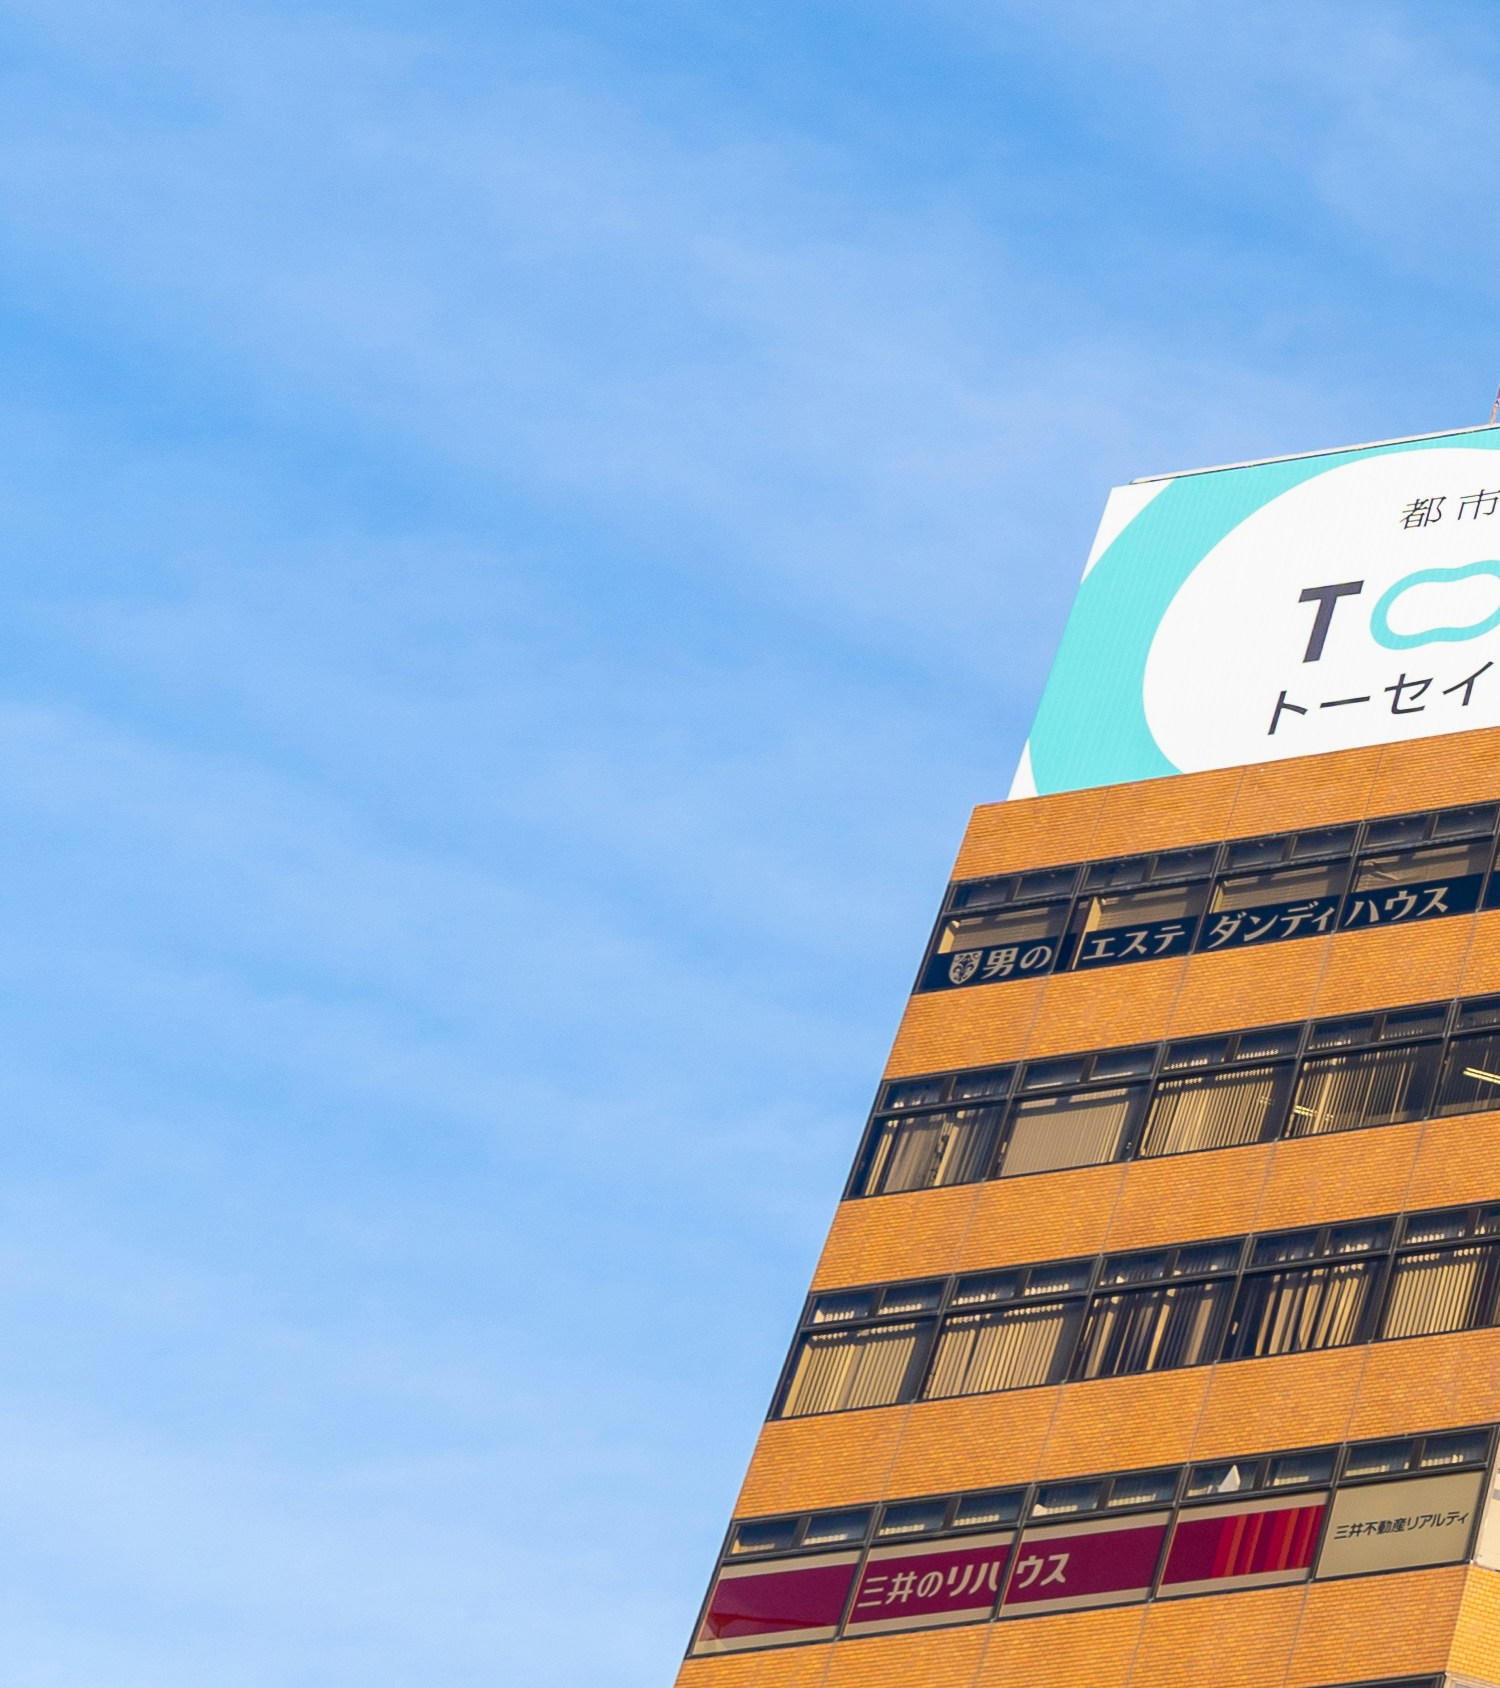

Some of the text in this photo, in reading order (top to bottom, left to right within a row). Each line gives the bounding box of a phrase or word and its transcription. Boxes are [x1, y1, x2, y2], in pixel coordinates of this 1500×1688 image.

[1333, 1510, 1470, 1541] 三井不動産リアルティ
[856, 1552, 1071, 1608] 三井のリハウス
